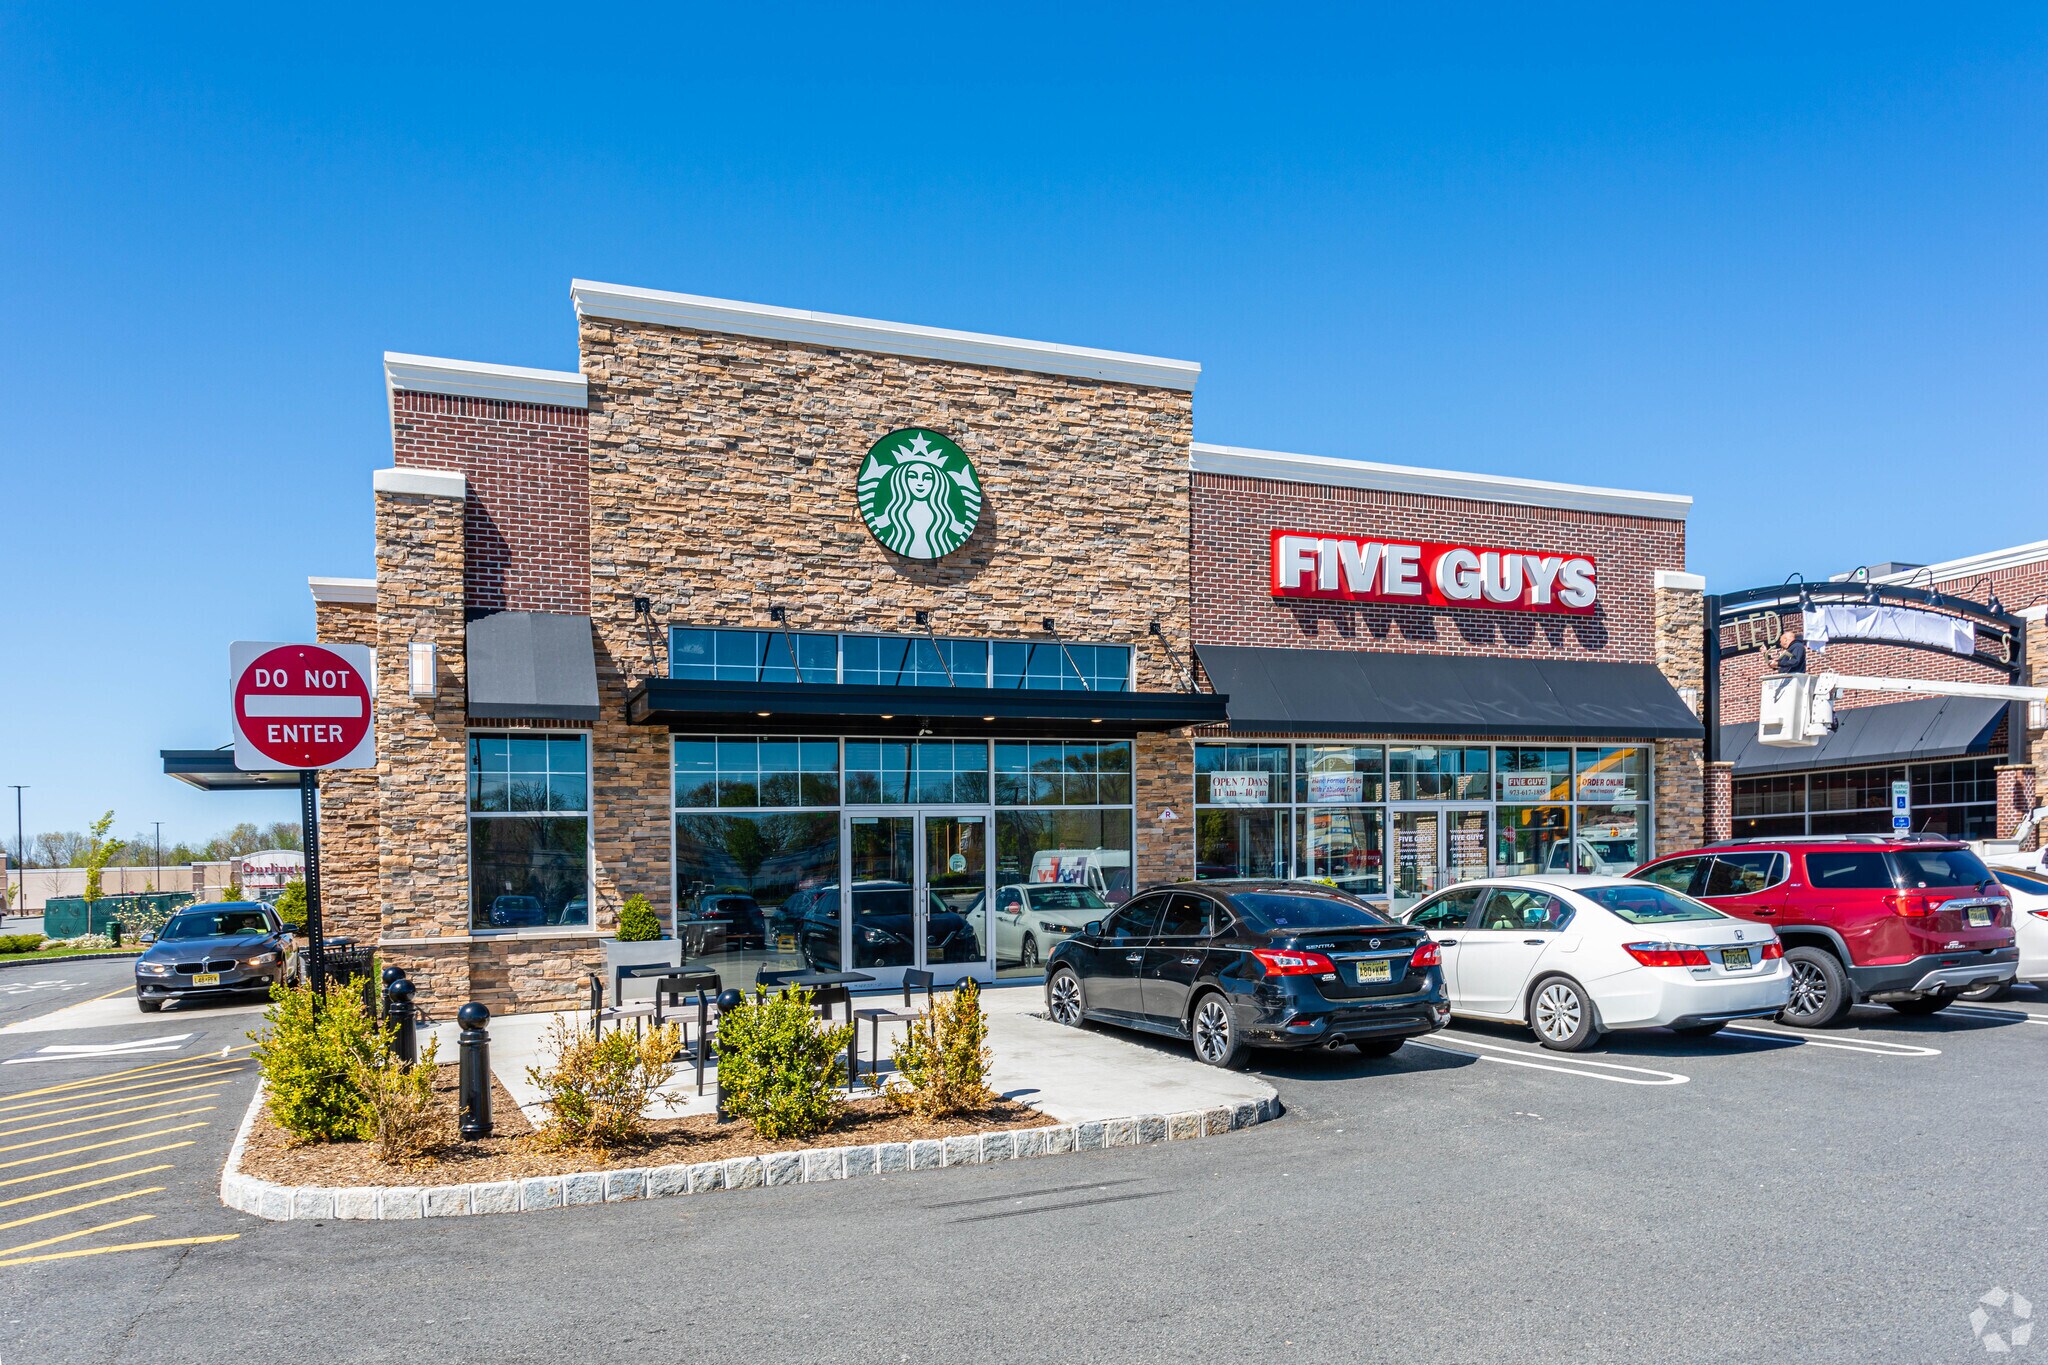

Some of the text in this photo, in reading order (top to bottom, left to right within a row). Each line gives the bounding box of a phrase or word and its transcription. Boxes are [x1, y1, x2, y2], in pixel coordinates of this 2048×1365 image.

[1279, 535, 1597, 609] FIVE GUYS
[1733, 610, 1782, 651] LED
[255, 668, 350, 689] DO NOT
[267, 724, 344, 743] ENTER
[1212, 776, 1269, 787] OPEN 7 DAYS
[1509, 778, 1526, 786] FIVE
[1582, 778, 1624, 787] ORDER ONLINE
[1214, 788, 1222, 797] 11
[1245, 788, 1253, 797] 10
[242, 862, 306, 876] Burlingo
